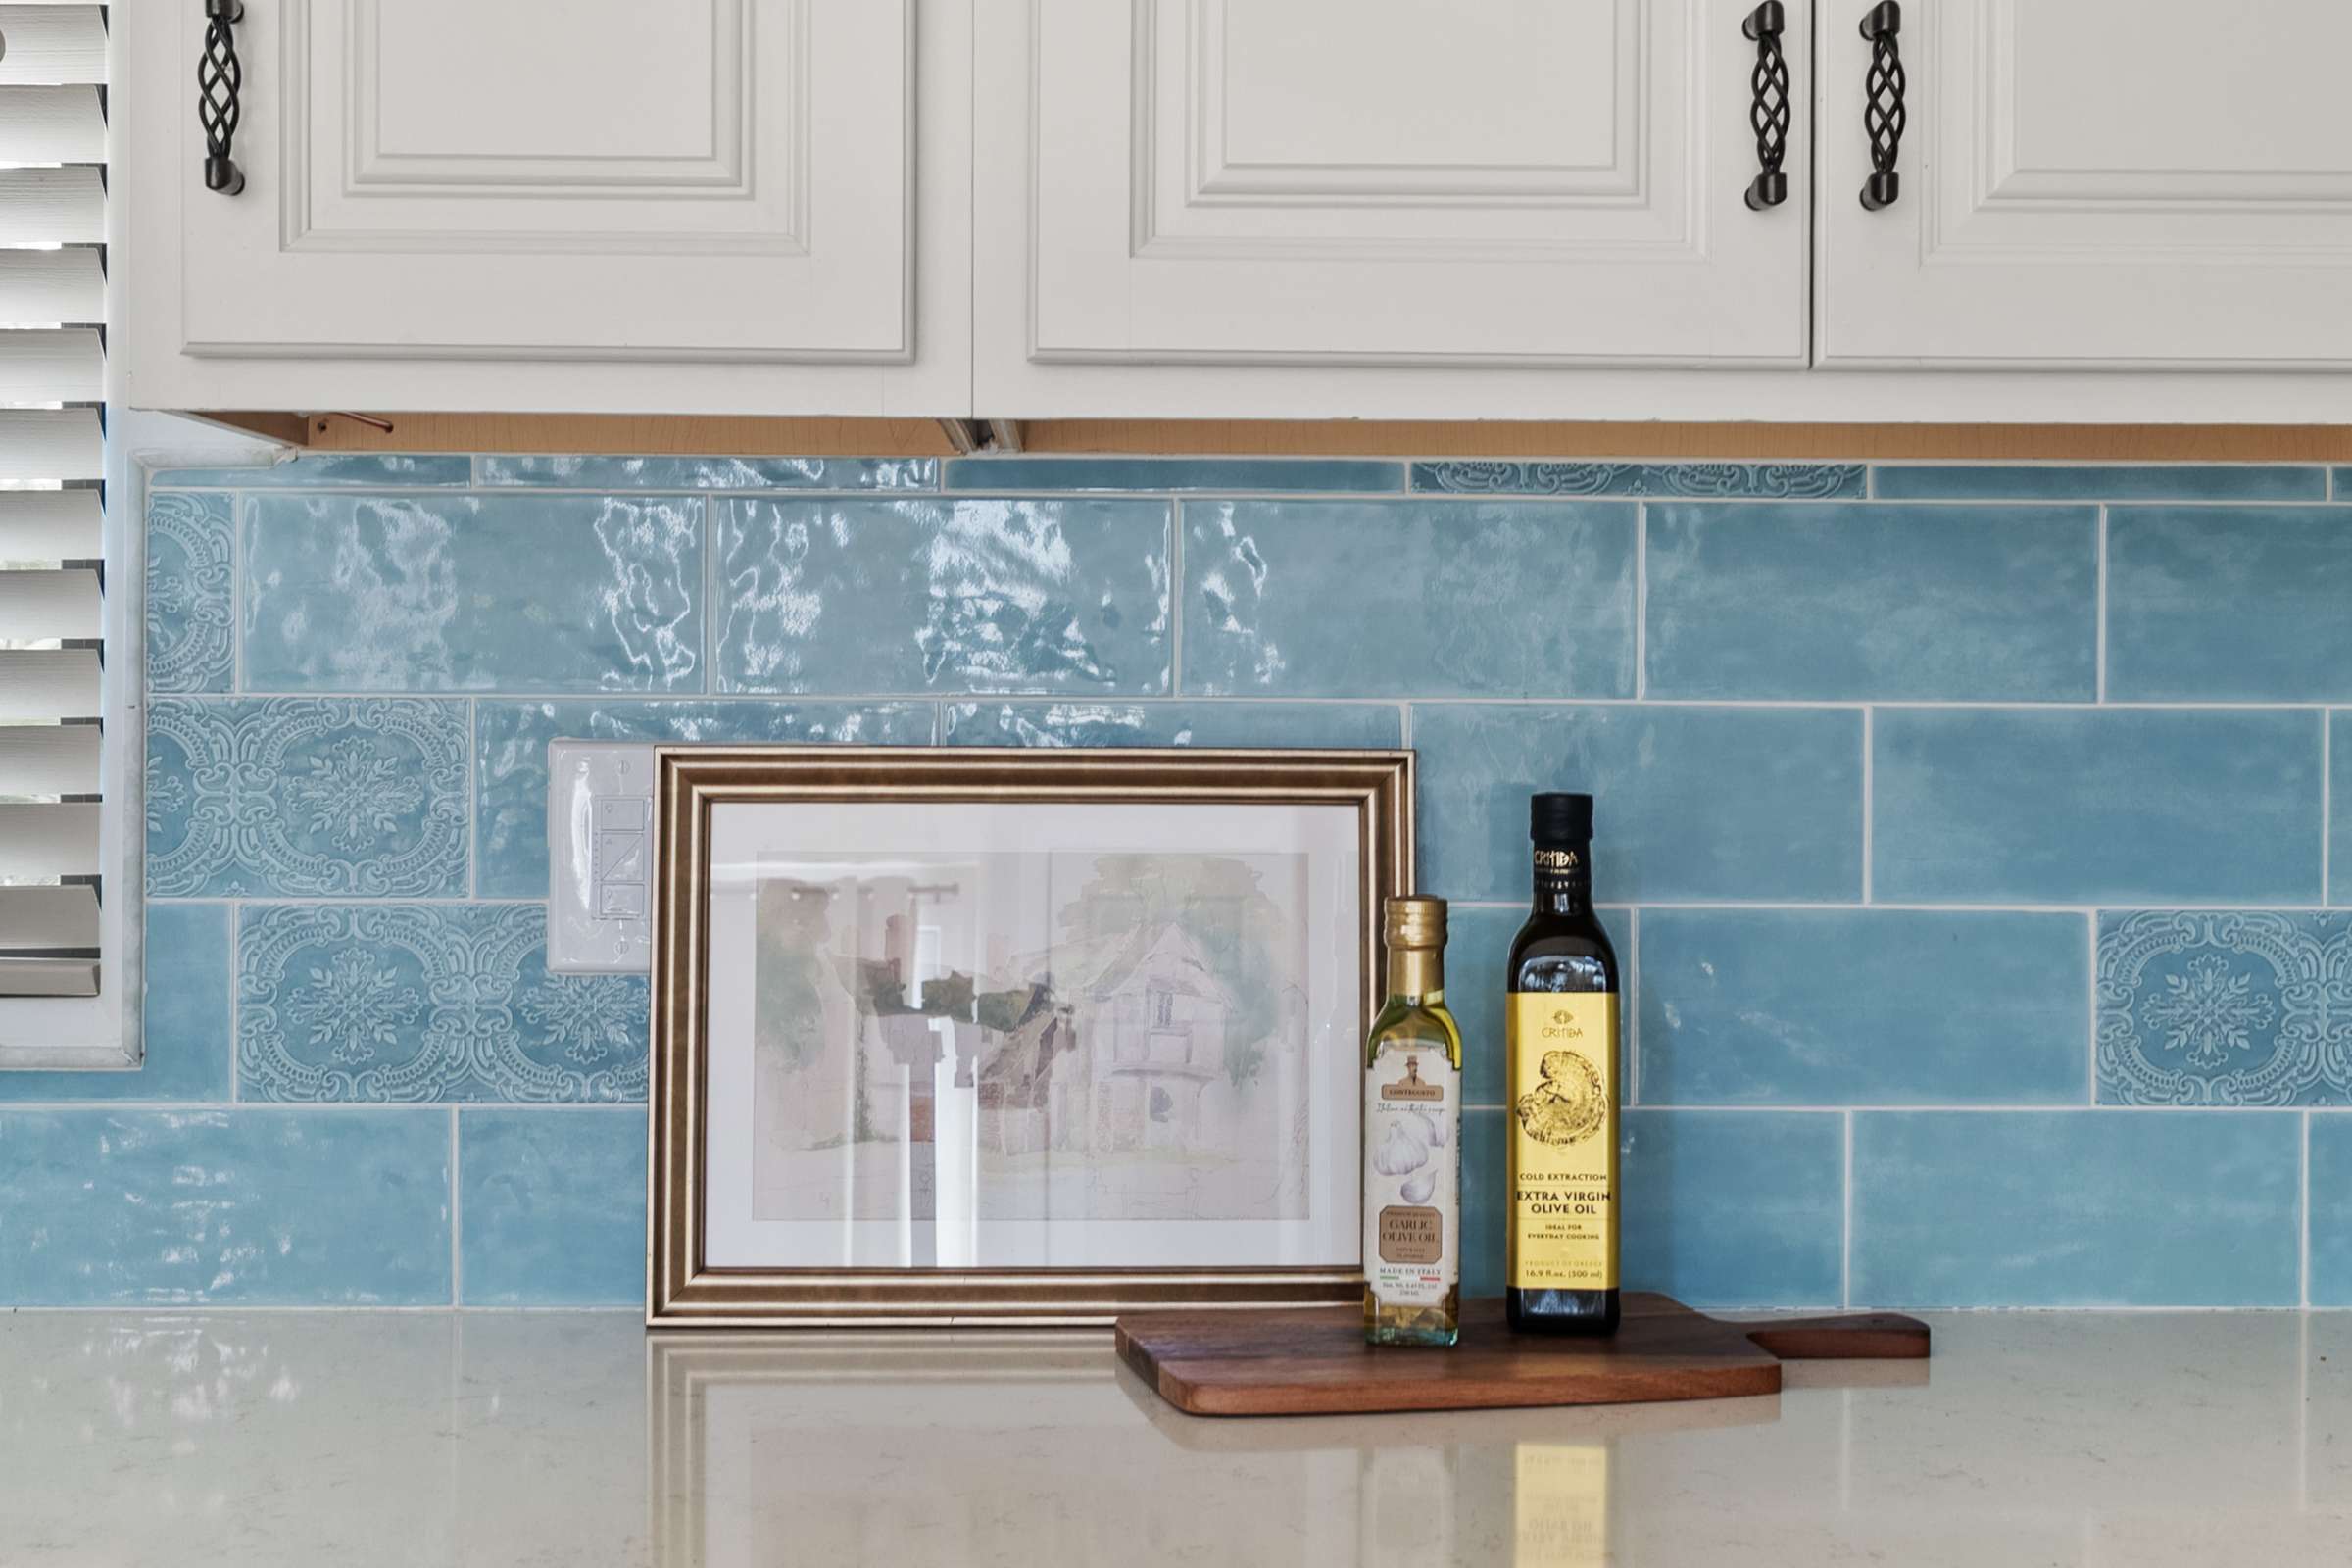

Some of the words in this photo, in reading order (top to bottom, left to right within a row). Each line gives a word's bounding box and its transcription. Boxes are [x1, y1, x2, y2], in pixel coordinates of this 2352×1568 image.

[1542, 1027, 1584, 1039] CRITIDA
[1519, 1172, 1544, 1182] COLD
[1547, 1172, 1607, 1182] EXTRACTION
[1516, 1190, 1560, 1201] EXTRA
[1563, 1191, 1612, 1202] VIRGIN
[1531, 1202, 1570, 1214] OLIVE
[1574, 1203, 1597, 1215] OIL
[1389, 1219, 1433, 1230] GARLIC
[1382, 1231, 1417, 1242] OLIVE
[1418, 1232, 1440, 1243] OIL
[1525, 1269, 1544, 1278] 16.9
